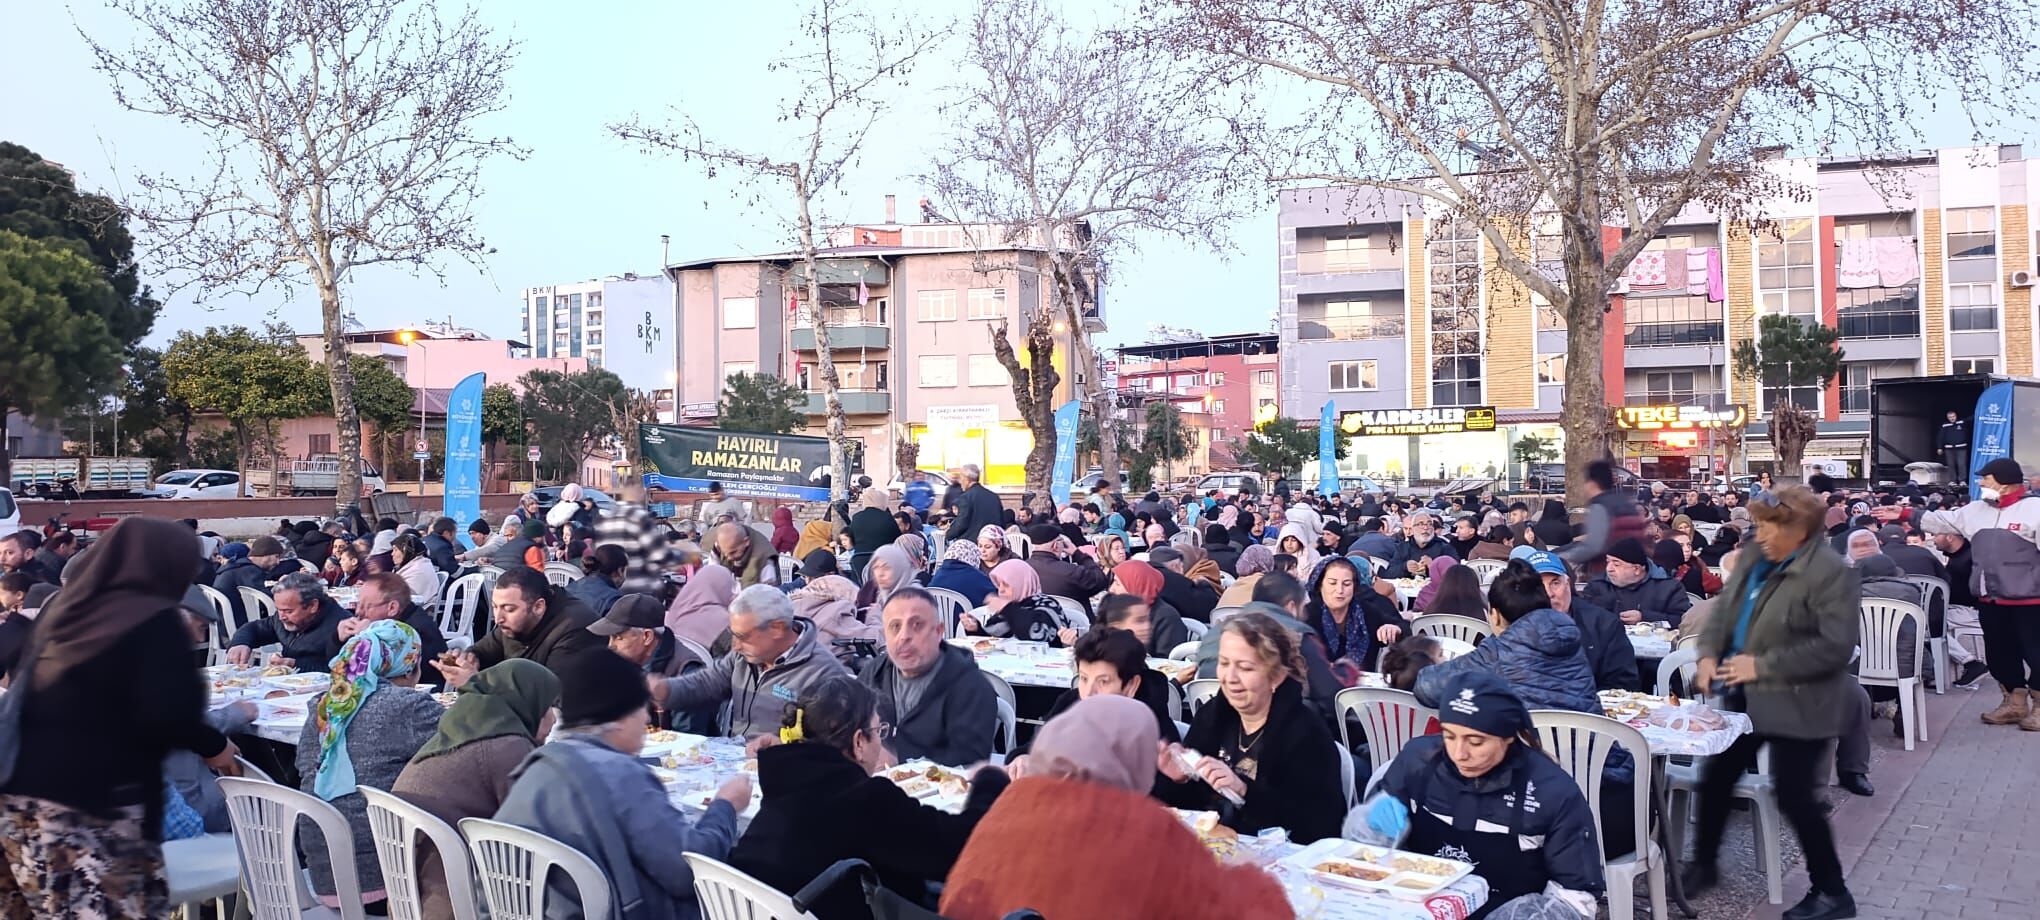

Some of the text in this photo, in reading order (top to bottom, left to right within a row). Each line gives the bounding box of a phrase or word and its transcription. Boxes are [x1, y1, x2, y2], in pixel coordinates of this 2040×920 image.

[532, 287, 552, 295] BKM
[1362, 408, 1465, 426] KARDEŞLER
[1625, 407, 1677, 421] TEKE
[717, 435, 779, 455] HAYIRLI
[692, 451, 802, 472] RAMAZANLAR
[707, 469, 785, 482] Ramazan Paylaşmaktır
